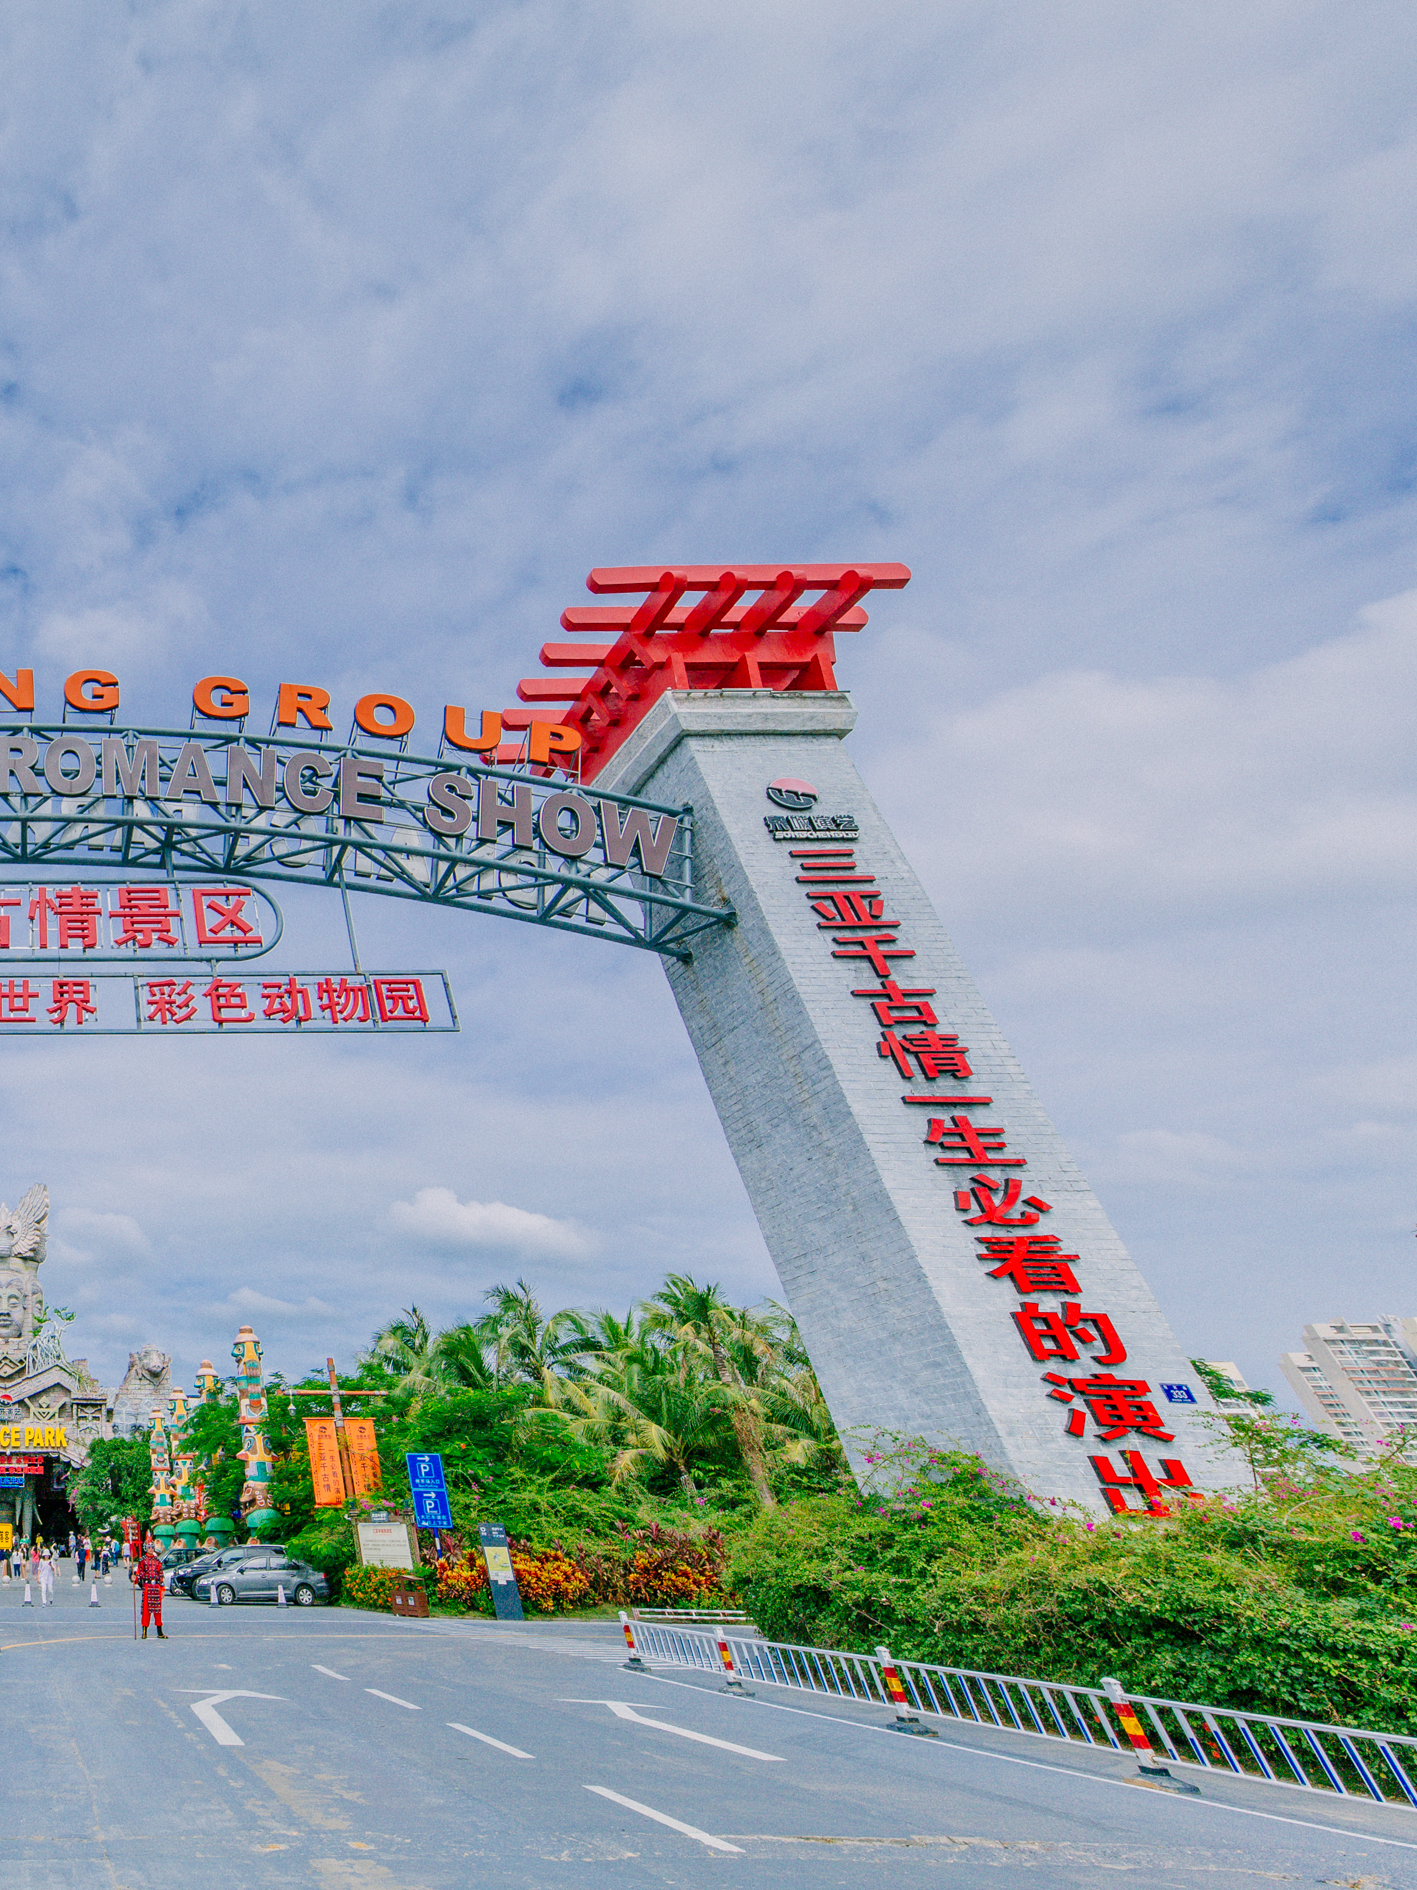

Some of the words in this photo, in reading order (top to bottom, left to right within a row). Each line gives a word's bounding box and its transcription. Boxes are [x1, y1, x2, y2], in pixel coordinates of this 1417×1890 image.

[192, 676, 582, 765] GROUP
[424, 772, 679, 879] SHOW
[146, 977, 430, 1025] 彩色动物园
[1170, 1390, 1189, 1399] 333
[24, 1426, 69, 1448] PARK
[317, 1442, 332, 1493] 三亚千古情
